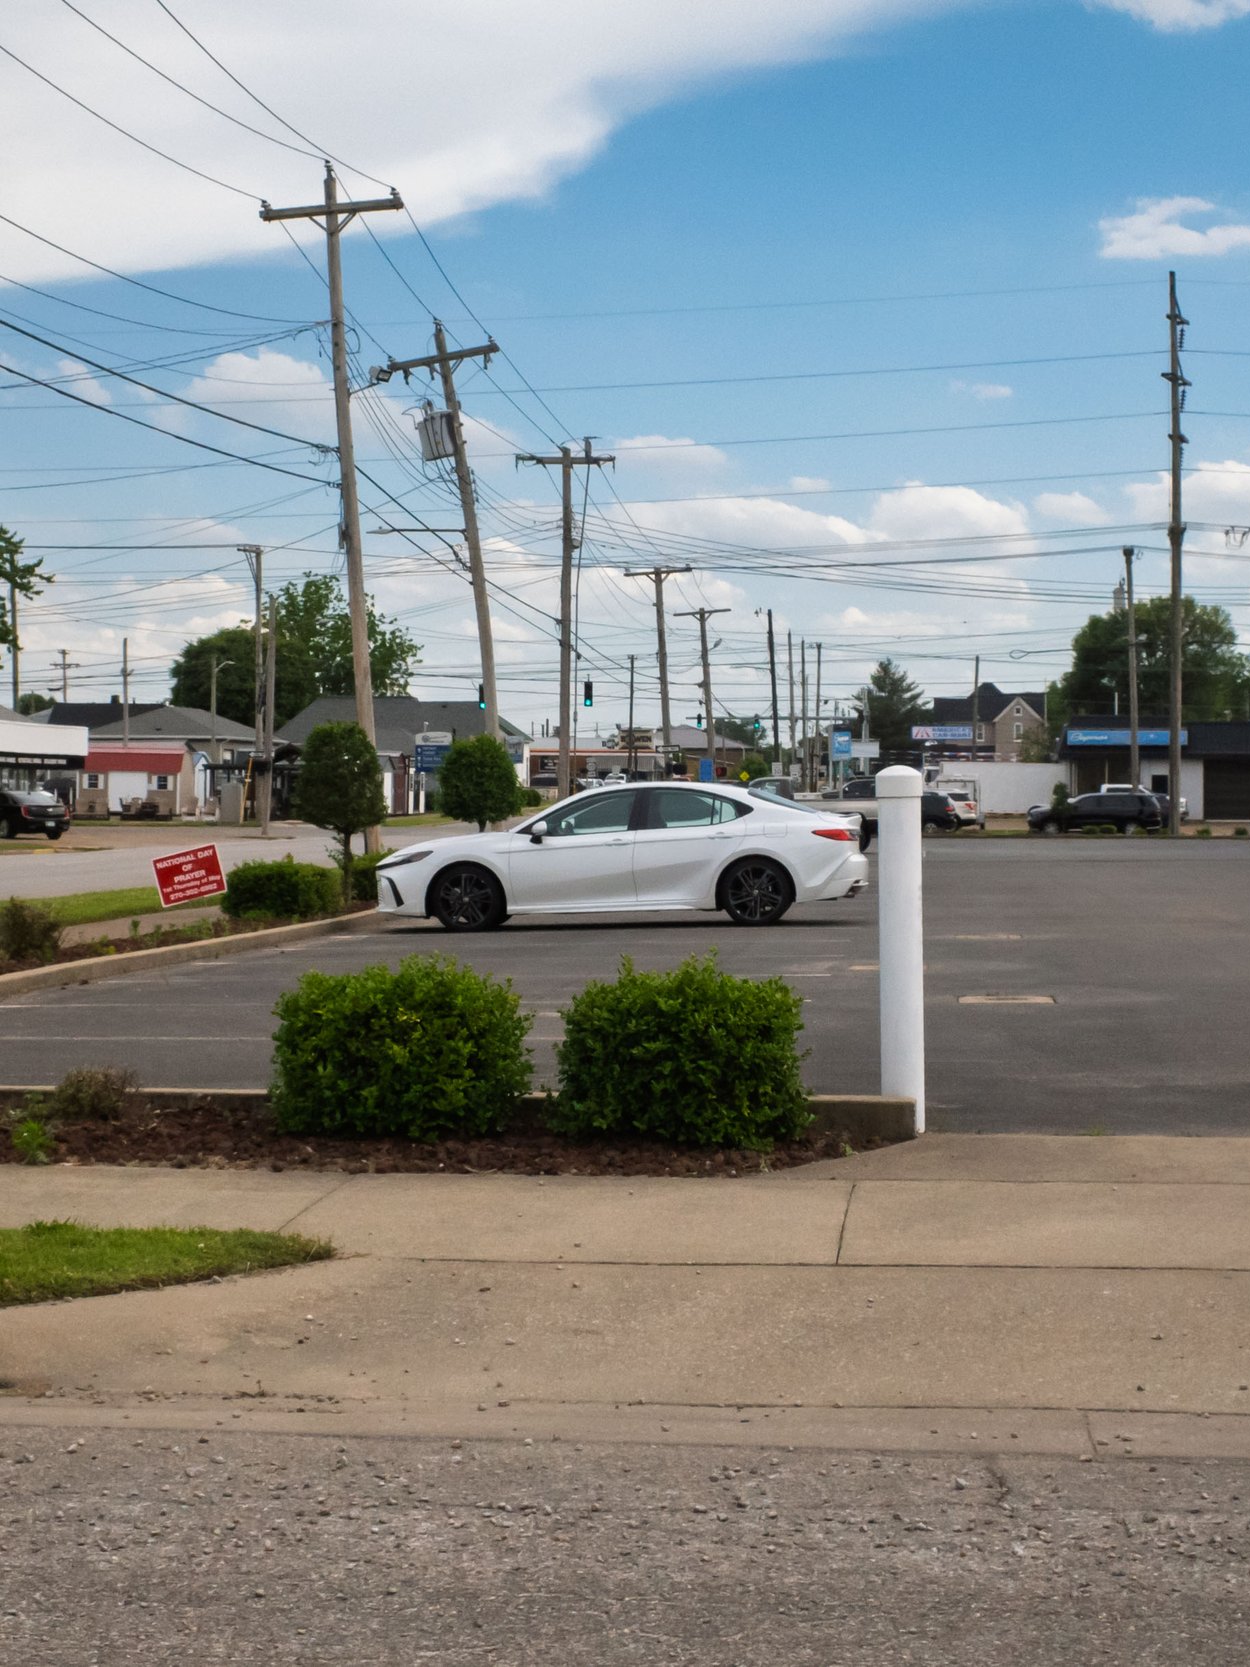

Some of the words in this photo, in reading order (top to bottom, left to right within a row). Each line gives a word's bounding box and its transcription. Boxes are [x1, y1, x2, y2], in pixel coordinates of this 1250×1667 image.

[156, 854, 196, 869] NATIONAL
[197, 849, 214, 859] DAY
[182, 863, 193, 872] OF
[174, 869, 206, 883] PRAYER
[173, 880, 201, 891] Thursday
